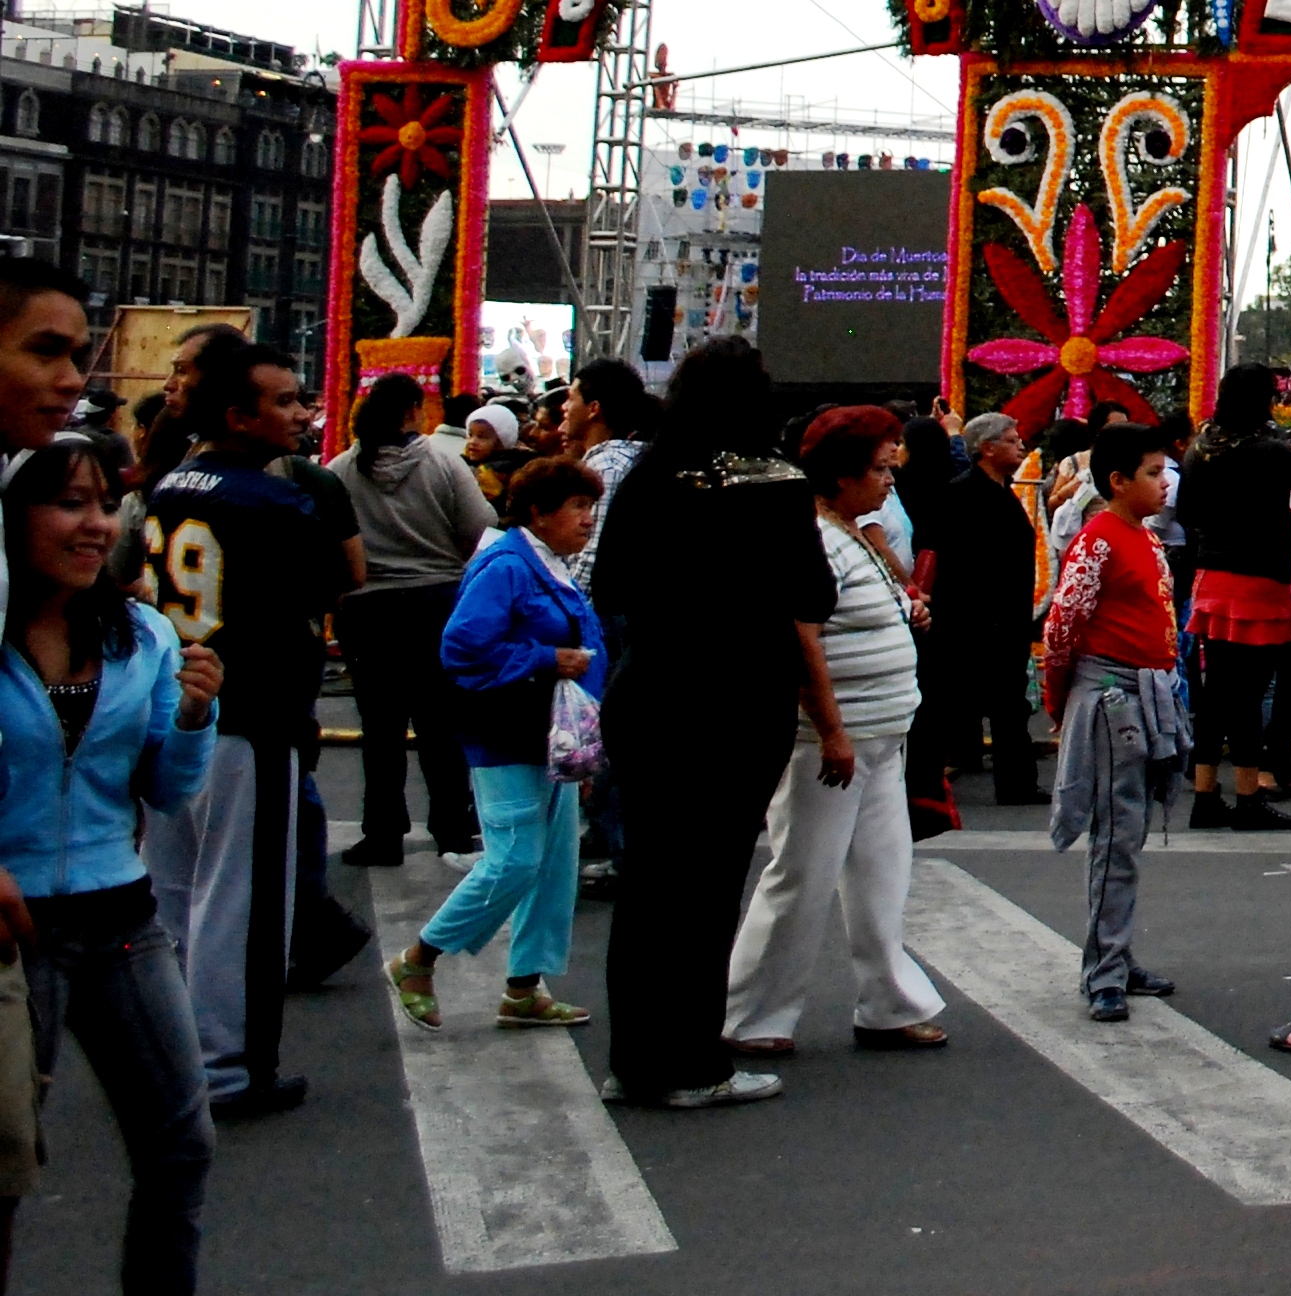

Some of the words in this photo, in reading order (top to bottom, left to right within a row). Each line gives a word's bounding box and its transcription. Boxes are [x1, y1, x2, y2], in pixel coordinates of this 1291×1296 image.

[871, 247, 887, 262] de
[795, 265, 807, 282] la
[809, 266, 866, 281] tradición
[869, 269, 894, 281] más
[923, 266, 939, 281] de
[804, 284, 872, 302] Patrimonio
[876, 284, 892, 300] de
[895, 284, 907, 300] la
